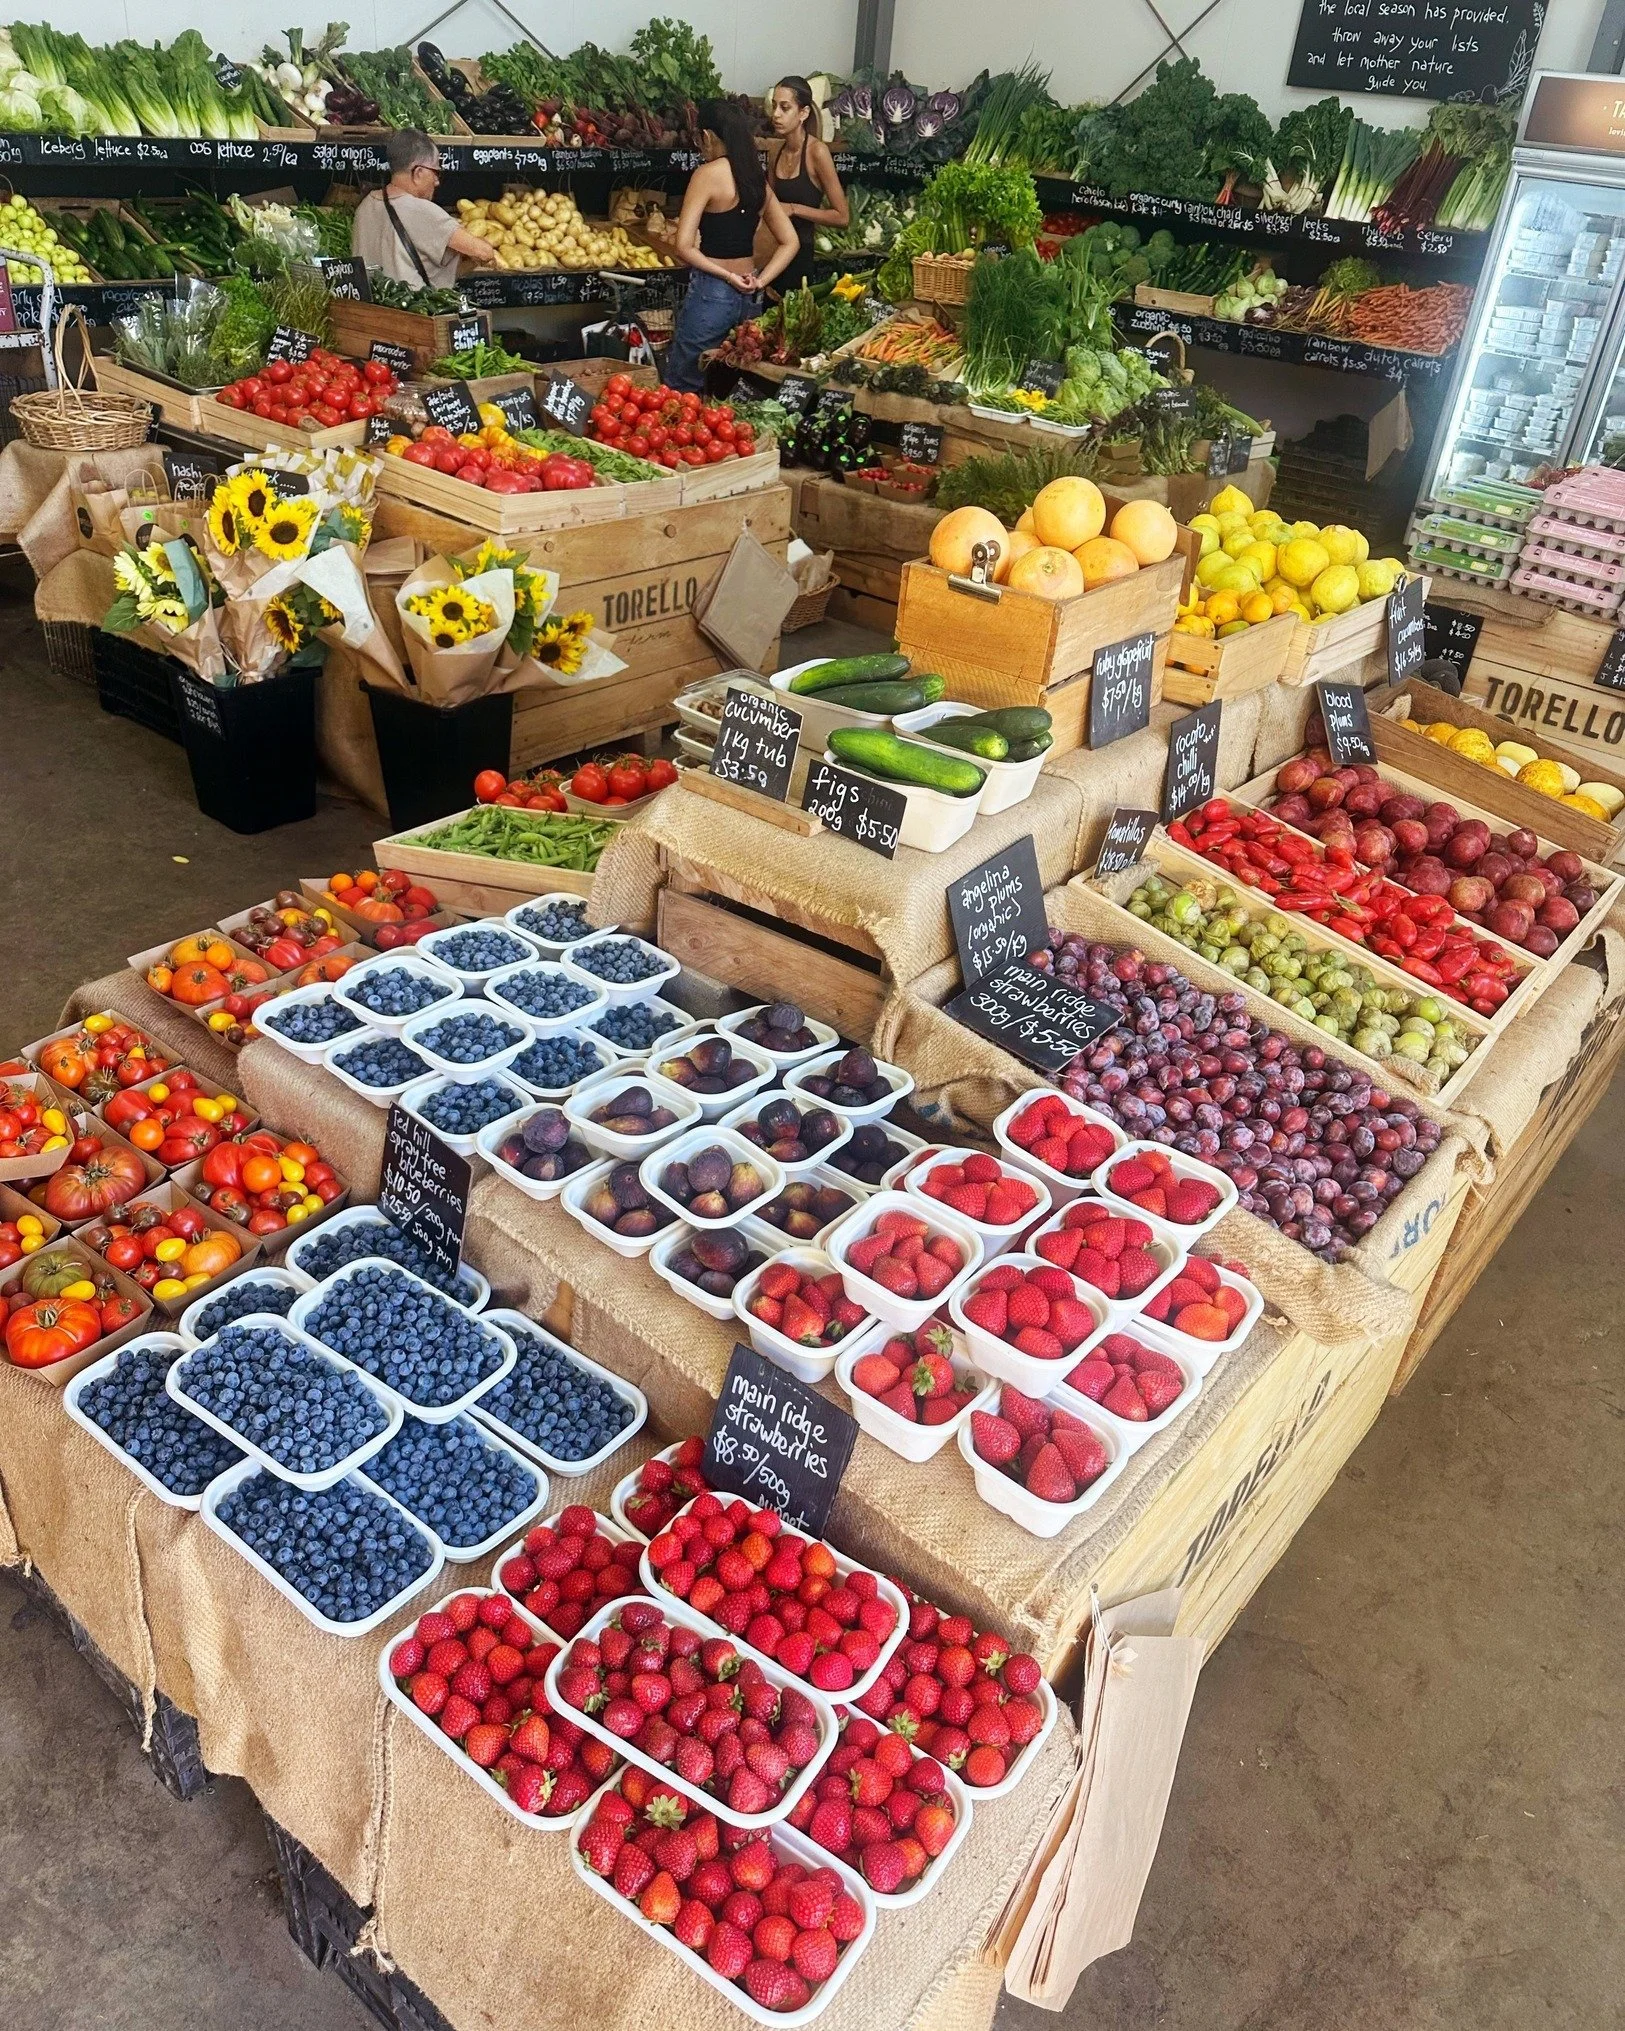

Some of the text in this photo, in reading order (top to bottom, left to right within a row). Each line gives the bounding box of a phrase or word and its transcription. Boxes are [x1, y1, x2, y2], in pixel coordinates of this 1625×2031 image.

[1319, 0, 1510, 30] the local season has provided.
[1332, 27, 1479, 54] throw away your lists
[1308, 51, 1454, 74] and let mother nature
[1365, 75, 1396, 91] guide
[40, 136, 86, 160] iceberg
[95, 138, 131, 156] lettuce
[217, 142, 255, 160] lettuce
[312, 144, 374, 160] salad onions
[473, 148, 513, 166] eggplants
[1129, 193, 1160, 205] organic
[1217, 207, 1242, 220] chard
[1302, 216, 1329, 232] leeks
[1416, 230, 1453, 248] celery
[454, 322, 479, 341] spiral
[1136, 309, 1171, 326] organic
[1304, 352, 1338, 366] carrots
[1364, 350, 1442, 377] dutch carrots
[603, 577, 697, 628] TORELLO
[1096, 650, 1115, 680] ruby
[740, 693, 788, 721] organic
[1325, 690, 1353, 709] blood
[1485, 676, 1625, 745] TORELLO
[725, 701, 800, 741] cucumber
[1329, 710, 1353, 732] plums
[755, 738, 786, 768] tub
[1177, 746, 1198, 779] chilli
[812, 766, 860, 812] figs
[808, 799, 898, 850] 200g $5.50
[961, 865, 1010, 913] angelina
[988, 876, 1023, 917] plums
[1004, 965, 1096, 1017] main ridge
[990, 978, 1096, 1038] strawberries
[412, 1123, 431, 1152] hill
[389, 1130, 447, 1180] spray free
[399, 1155, 463, 1214] blueberries
[731, 1374, 828, 1446] main ridge
[725, 1399, 828, 1479] strawberries
